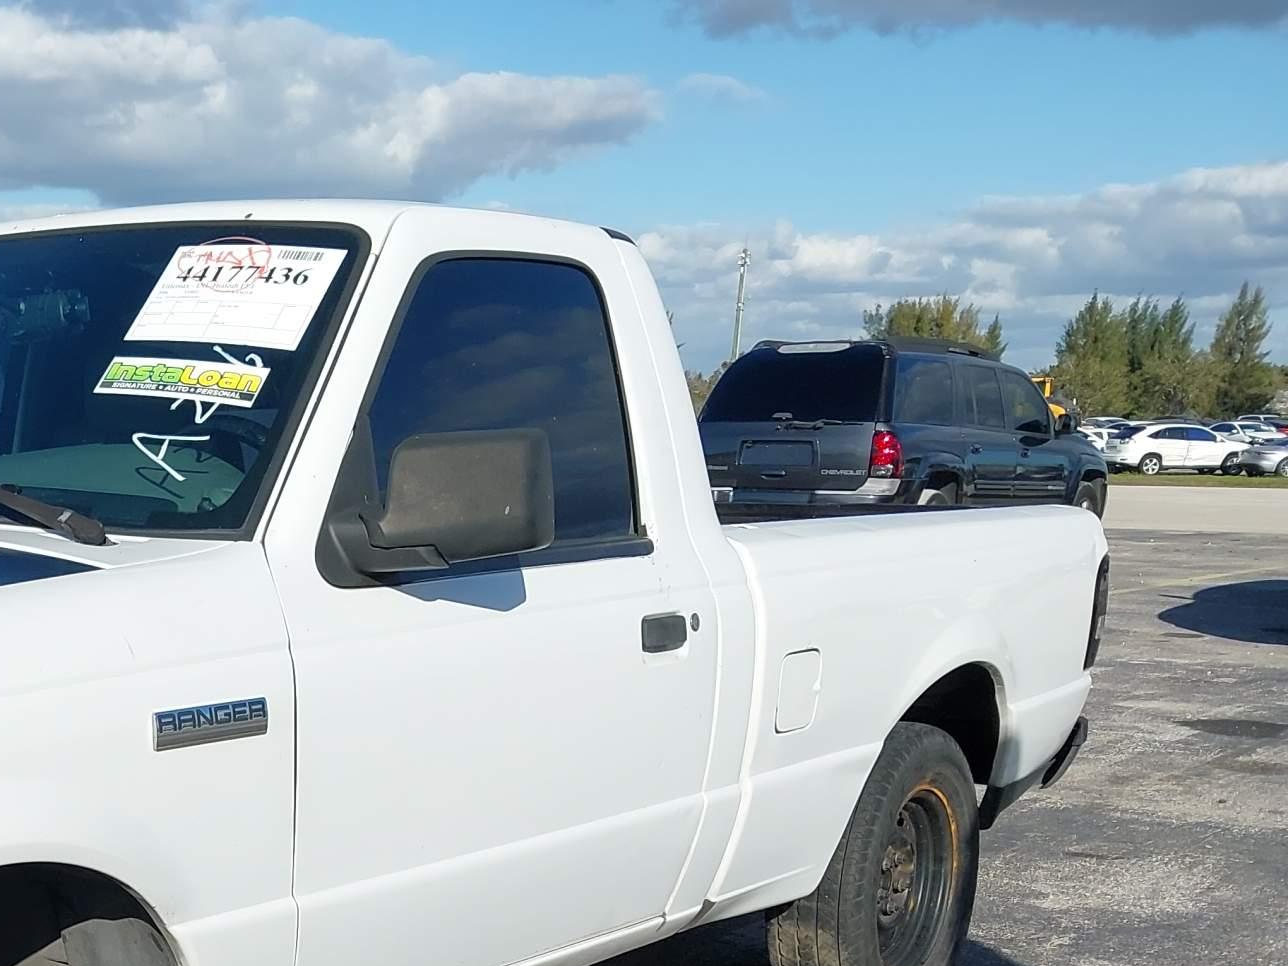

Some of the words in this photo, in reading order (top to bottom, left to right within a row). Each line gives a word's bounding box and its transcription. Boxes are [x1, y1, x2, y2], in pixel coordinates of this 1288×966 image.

[176, 265, 312, 286] 44177436
[104, 362, 262, 393] InstaLoan
[111, 381, 160, 391] SIGNATURE
[195, 387, 242, 400] PERSONAL
[157, 700, 267, 733] RANGER
